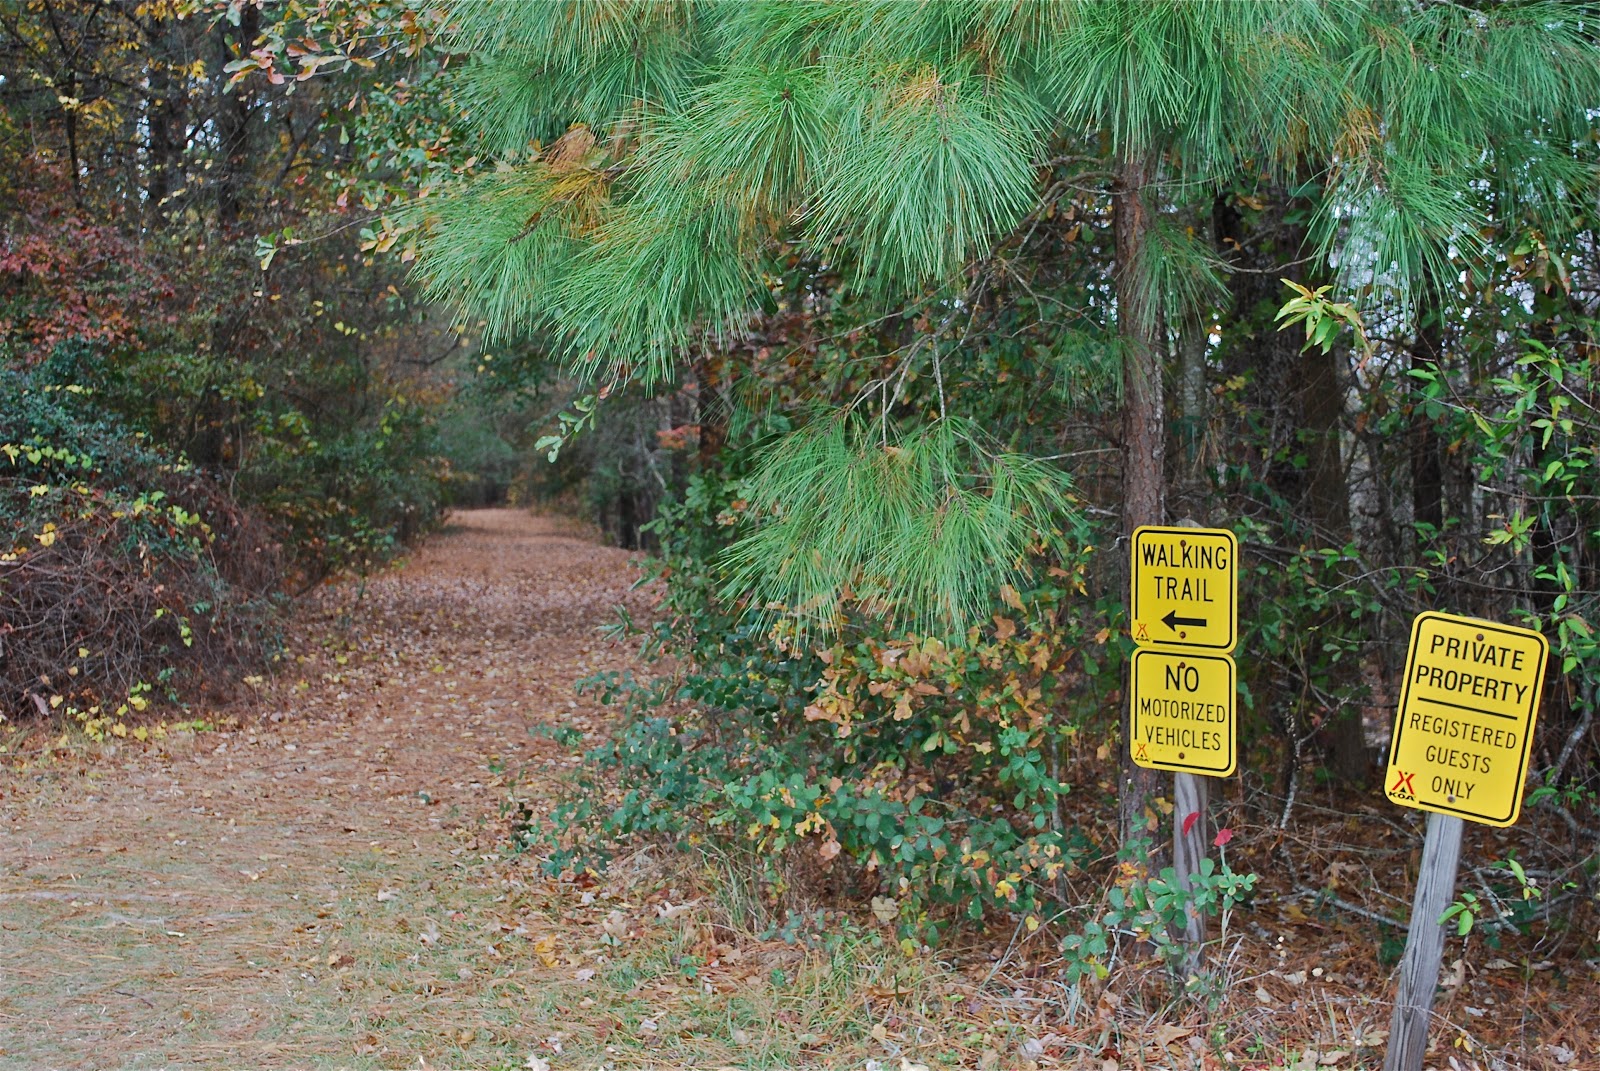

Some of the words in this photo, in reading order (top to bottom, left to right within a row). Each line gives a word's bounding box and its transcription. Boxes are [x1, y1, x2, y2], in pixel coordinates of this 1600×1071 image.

[1142, 543, 1227, 570] WALKING
[1154, 576, 1213, 602] TRAIL
[1430, 634, 1525, 671] PRIVATE
[1165, 664, 1199, 692] NO
[1415, 664, 1528, 705] PROPERTY
[1140, 698, 1226, 724] MOTORIZED
[1145, 725, 1221, 751] VEHICLES
[1409, 713, 1517, 749] REGISTERED
[1426, 745, 1492, 774] GUESTS
[1388, 791, 1415, 802] KOA
[1431, 775, 1476, 800] ONLY
